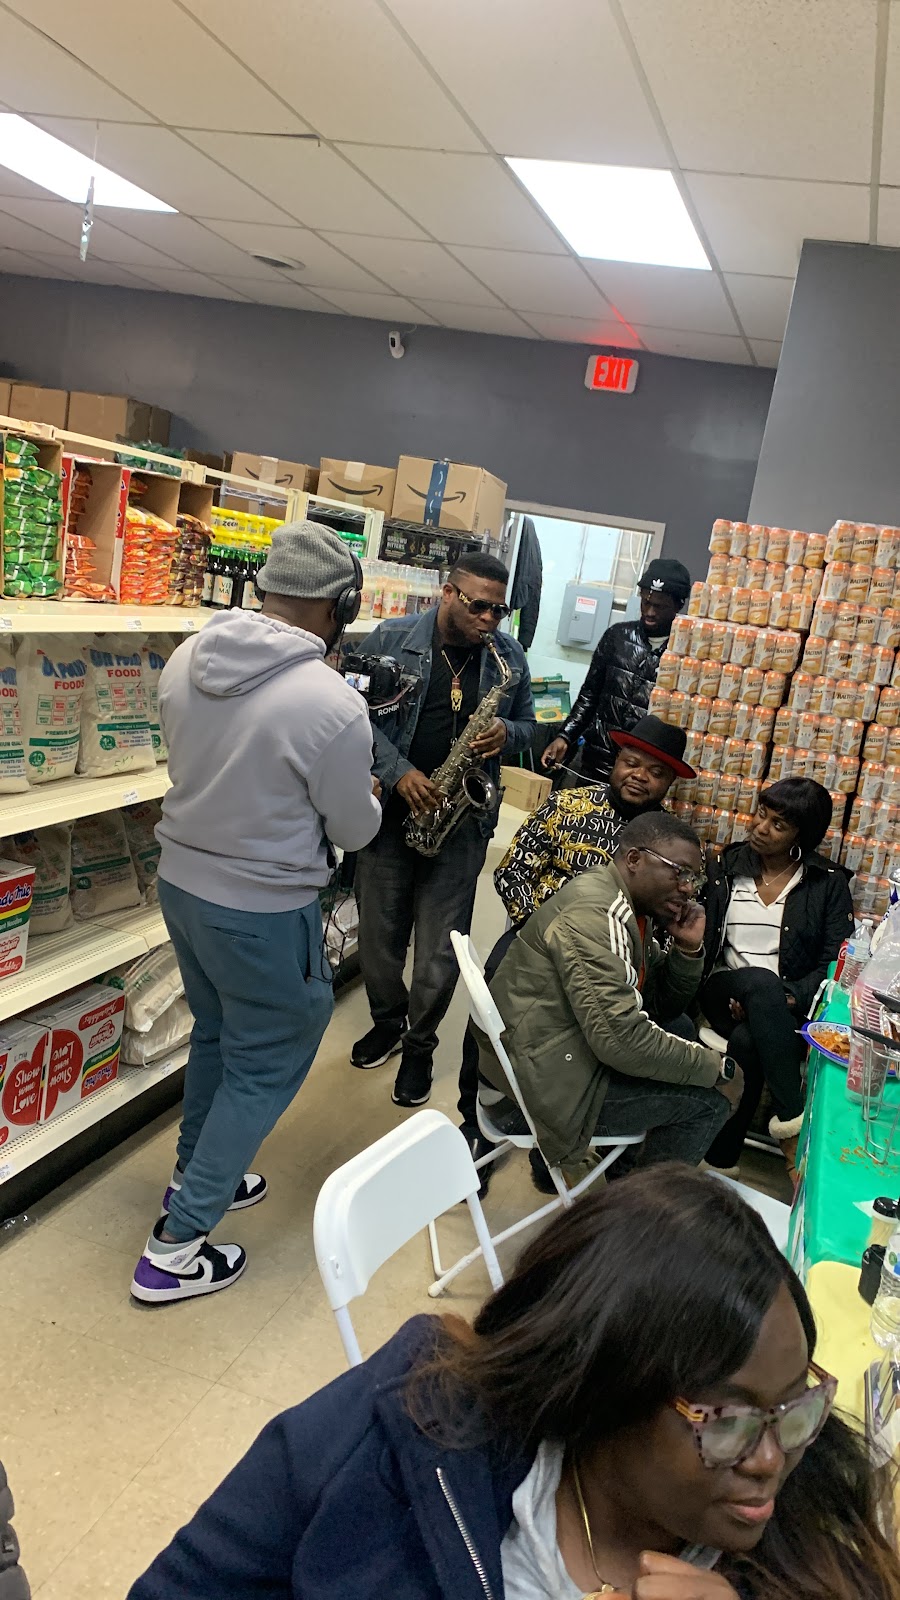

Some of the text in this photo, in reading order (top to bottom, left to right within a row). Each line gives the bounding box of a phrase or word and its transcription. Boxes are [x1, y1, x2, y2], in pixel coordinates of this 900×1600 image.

[593, 355, 633, 391] EXIT
[107, 669, 142, 678] FOODS
[54, 679, 85, 690] FOODS
[378, 703, 400, 717] RONIN
[51, 1040, 75, 1060] Love
[15, 1066, 41, 1088] Show
[49, 1066, 73, 1087] Show
[18, 1082, 35, 1097] some
[11, 1092, 37, 1116] Love
